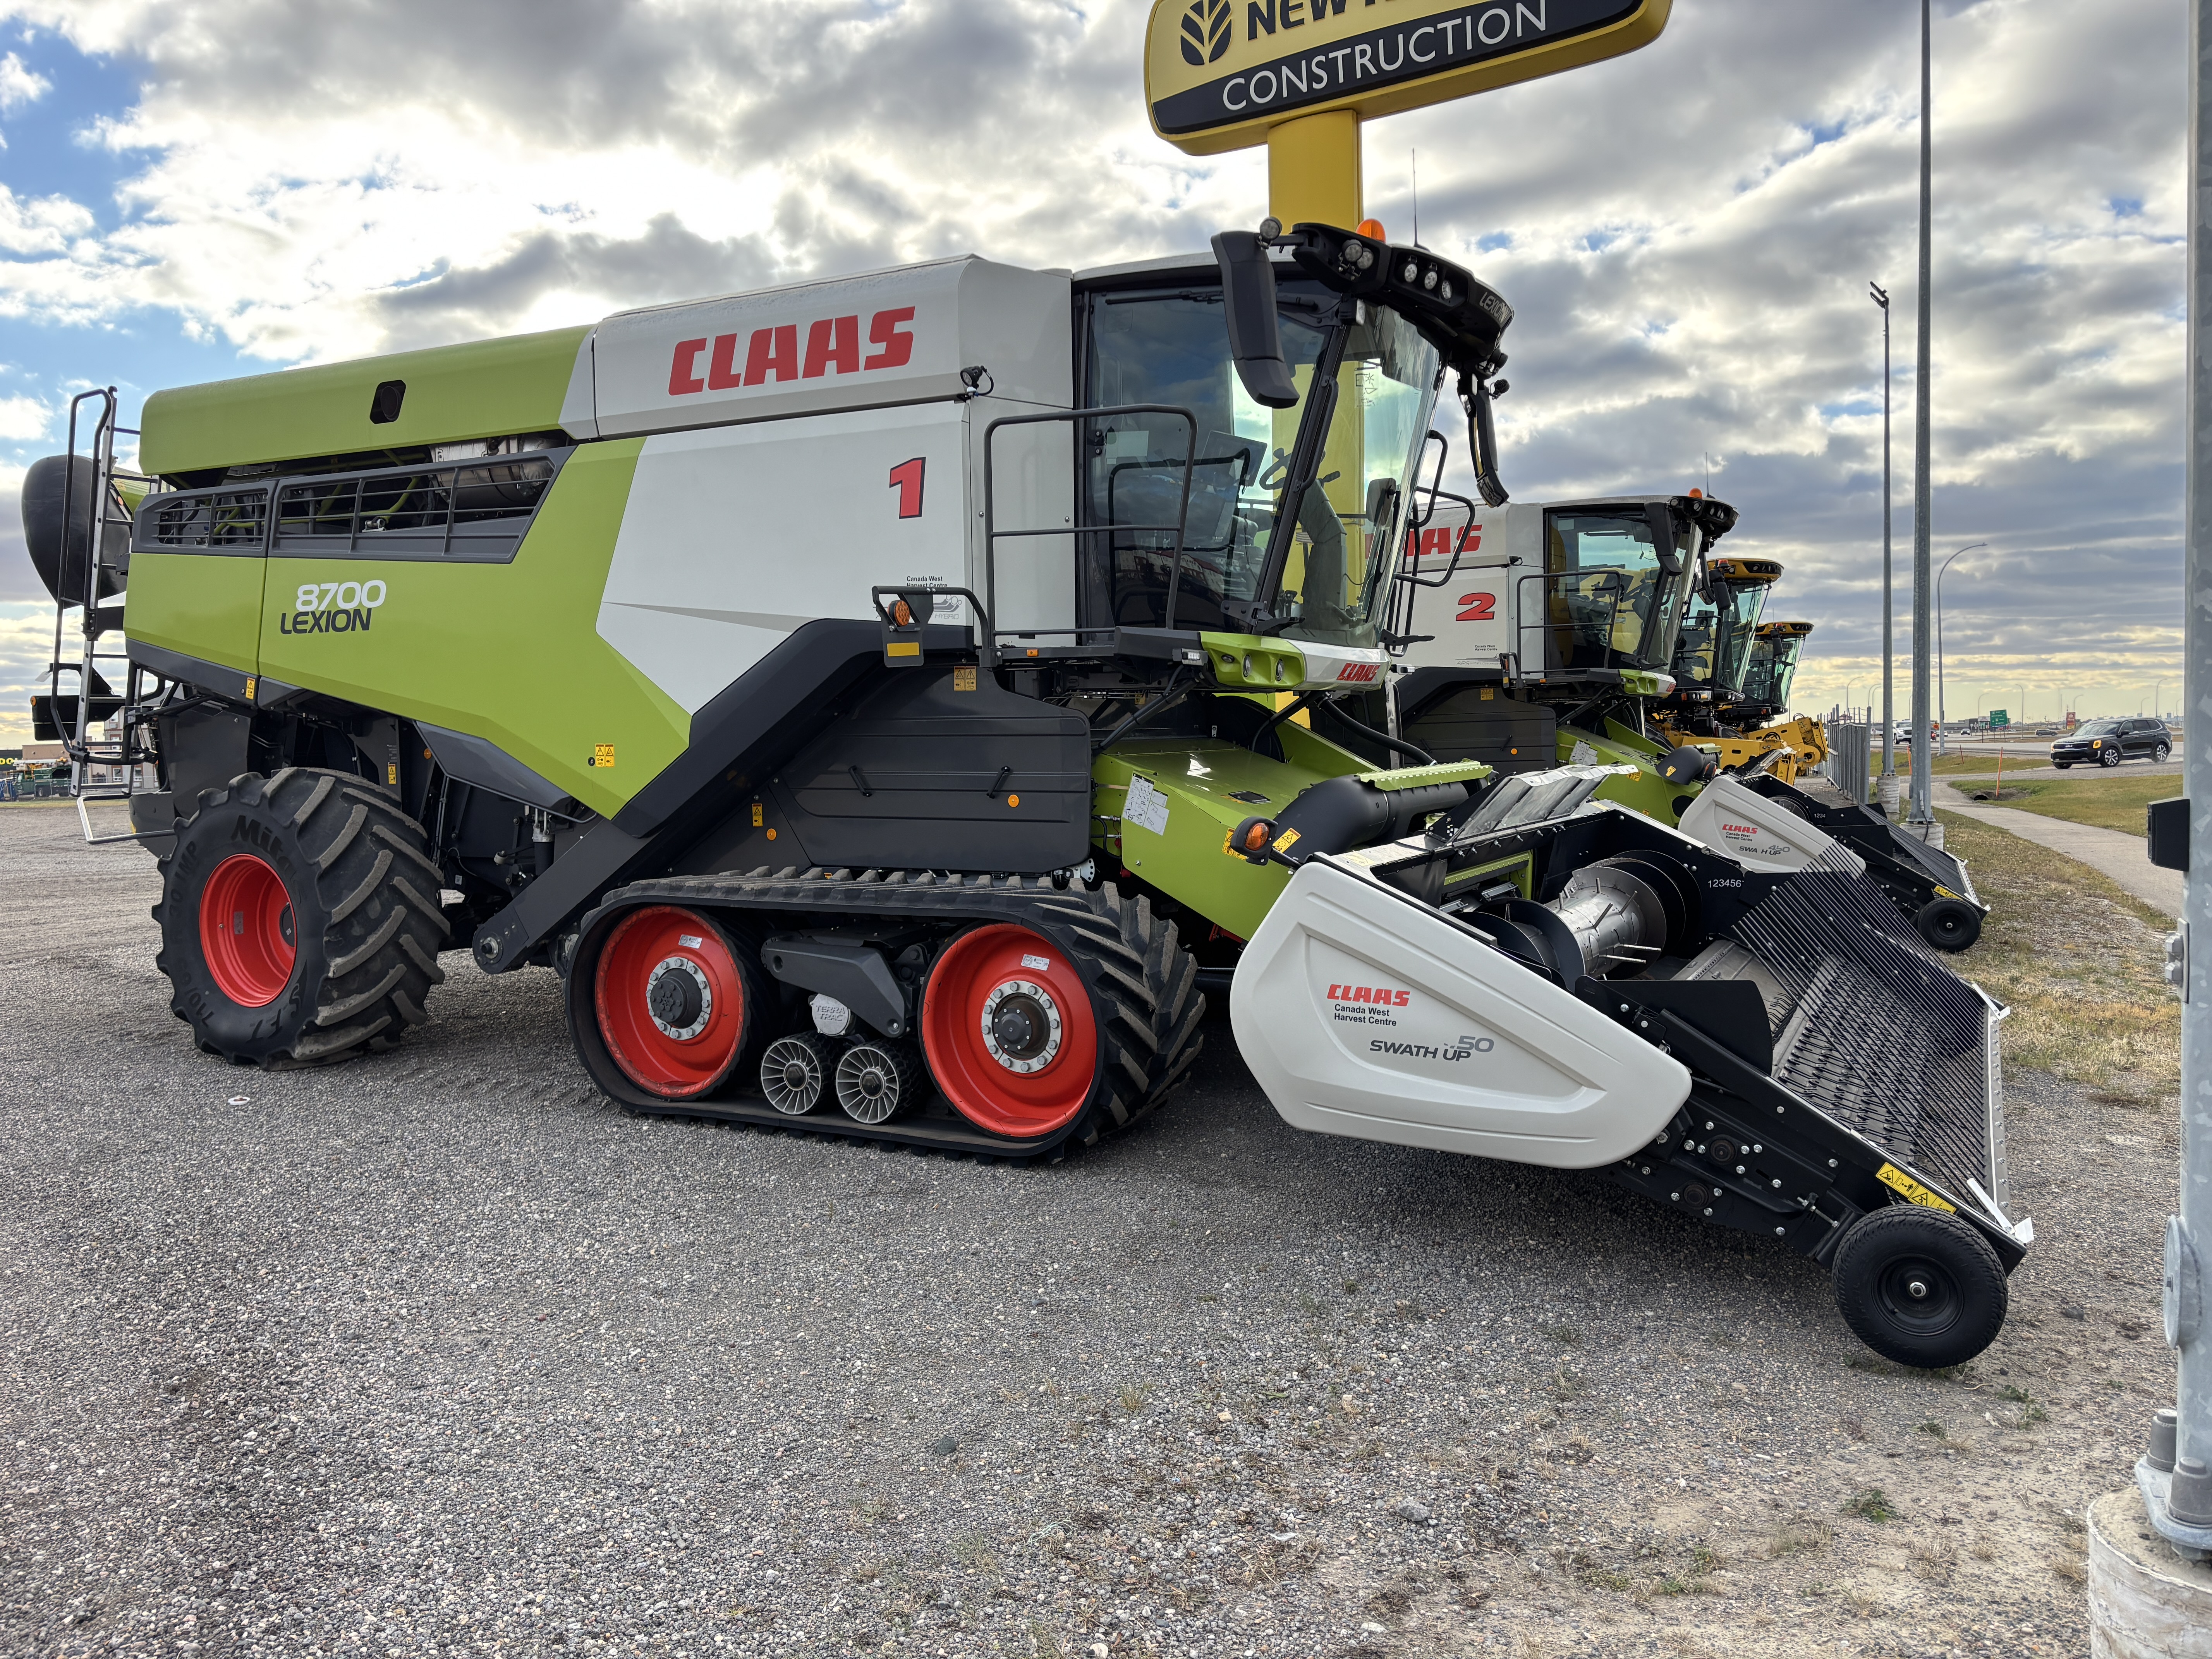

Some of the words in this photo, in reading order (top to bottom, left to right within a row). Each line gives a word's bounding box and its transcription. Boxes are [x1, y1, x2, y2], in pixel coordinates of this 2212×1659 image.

[1223, 0, 1546, 111] CONSTRUCTION
[1479, 292, 1509, 323] LEXION
[668, 306, 915, 396] CLAAS
[889, 457, 926, 519] 1
[296, 580, 386, 611] 8700
[1456, 592, 1496, 621] 2
[280, 608, 372, 634] LEXION
[1336, 663, 1381, 682] CLAAS
[1722, 824, 1758, 834] CLAAS
[175, 840, 196, 881] IMP
[1708, 879, 1744, 888] 123456
[1327, 984, 1410, 1006] CLAAS
[816, 1005, 845, 1014] TERRA
[1334, 1004, 1365, 1015] Canada
[1368, 1007, 1389, 1017] West
[1334, 1013, 1366, 1024] Harvest
[1368, 1016, 1397, 1026] Centre
[1369, 1040, 1438, 1060] SWATH
[1444, 1035, 1494, 1053] 50
[1443, 1048, 1471, 1062] UP
